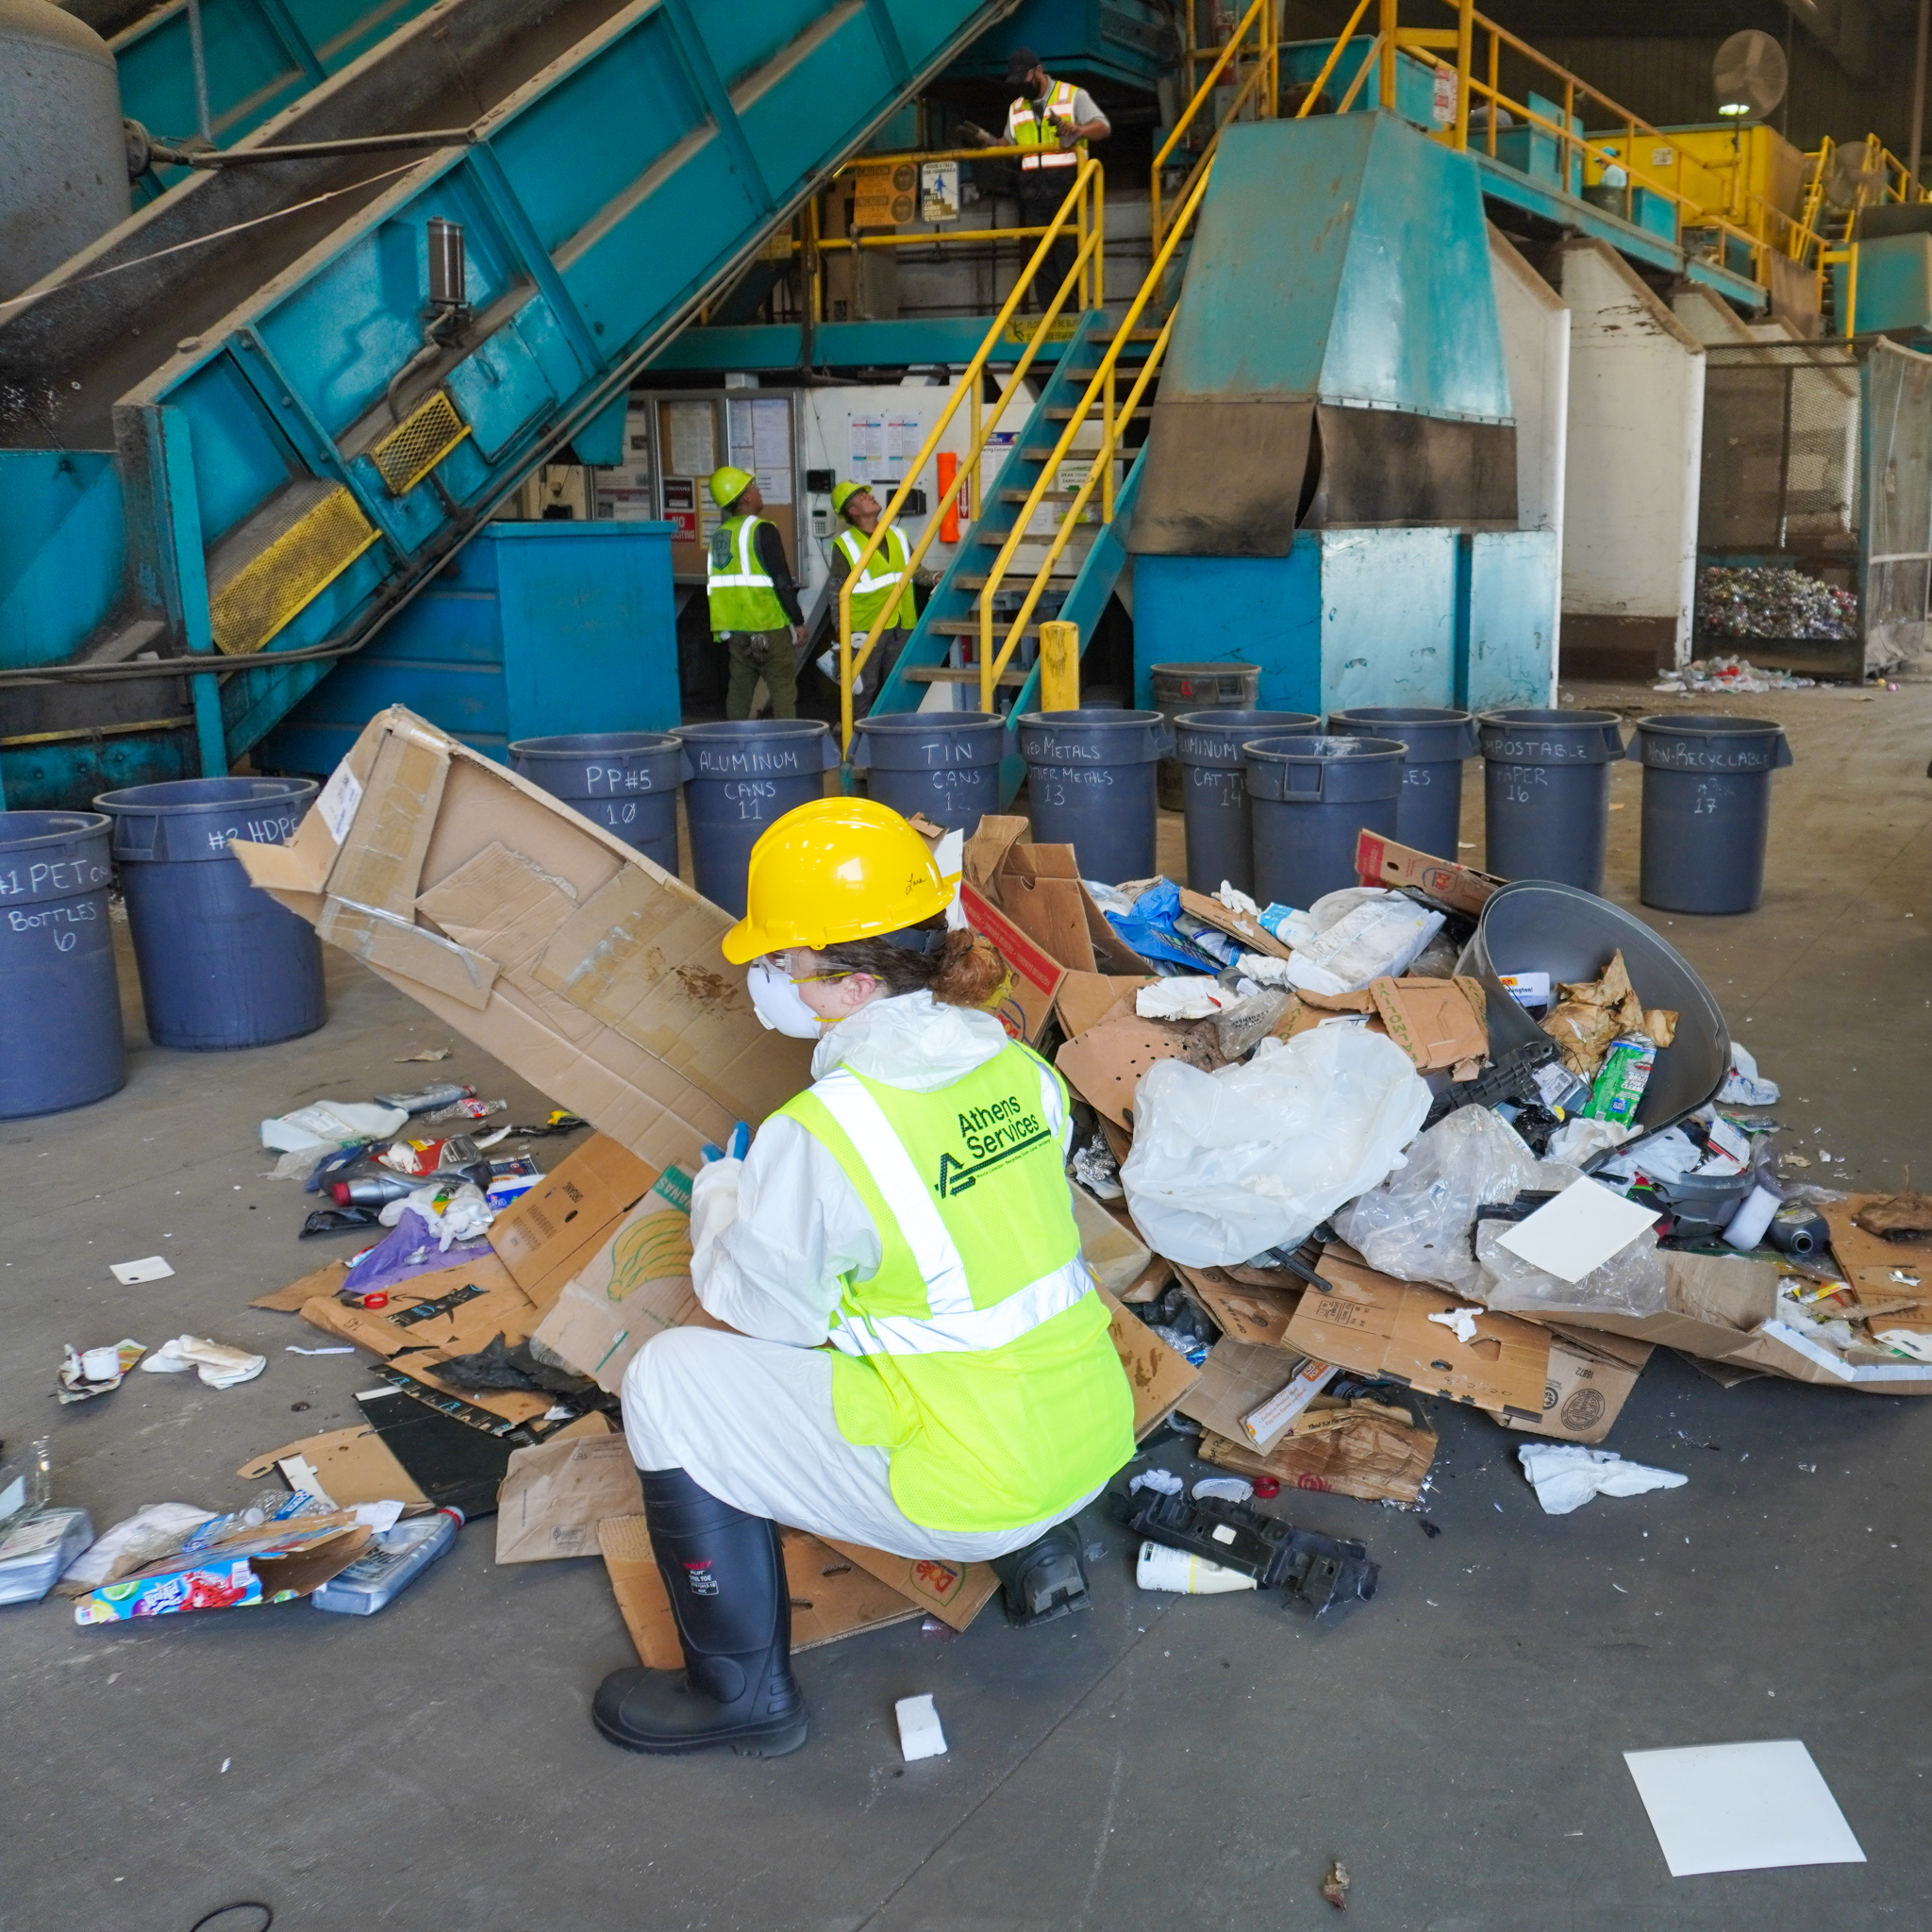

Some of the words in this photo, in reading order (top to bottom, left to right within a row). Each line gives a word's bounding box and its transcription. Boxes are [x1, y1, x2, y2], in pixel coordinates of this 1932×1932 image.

[921, 743, 972, 762] TIN
[1043, 736, 1101, 760] METALS
[1180, 737, 1238, 761] LUMINUM
[699, 751, 799, 772] ALUMINUM
[932, 770, 980, 790] CANS
[1062, 767, 1114, 786] METALS
[1193, 768, 1223, 787] CAT
[724, 781, 776, 800] CANS
[1043, 784, 1065, 806] 13
[1221, 788, 1242, 808] 14
[1507, 785, 1529, 802] 16
[739, 801, 763, 820] 11
[944, 791, 971, 812] 12
[1693, 797, 1717, 814] 17
[29, 859, 88, 893] PET
[8, 901, 96, 932] BOTTLES
[53, 928, 76, 952] 6
[1376, 982, 1418, 1063] PALMOLIVE
[958, 1095, 1021, 1139] Athens
[966, 1113, 1040, 1160] Services
[561, 1181, 584, 1204] ORGANIC
[658, 1176, 693, 1208] NANAS
[343, 1317, 364, 1332] 143
[1308, 1369, 1320, 1379] PCH
[1574, 1366, 1594, 1379] 16872
[1260, 1407, 1277, 1422] Exclusive
[1275, 1395, 1290, 1408] Product
